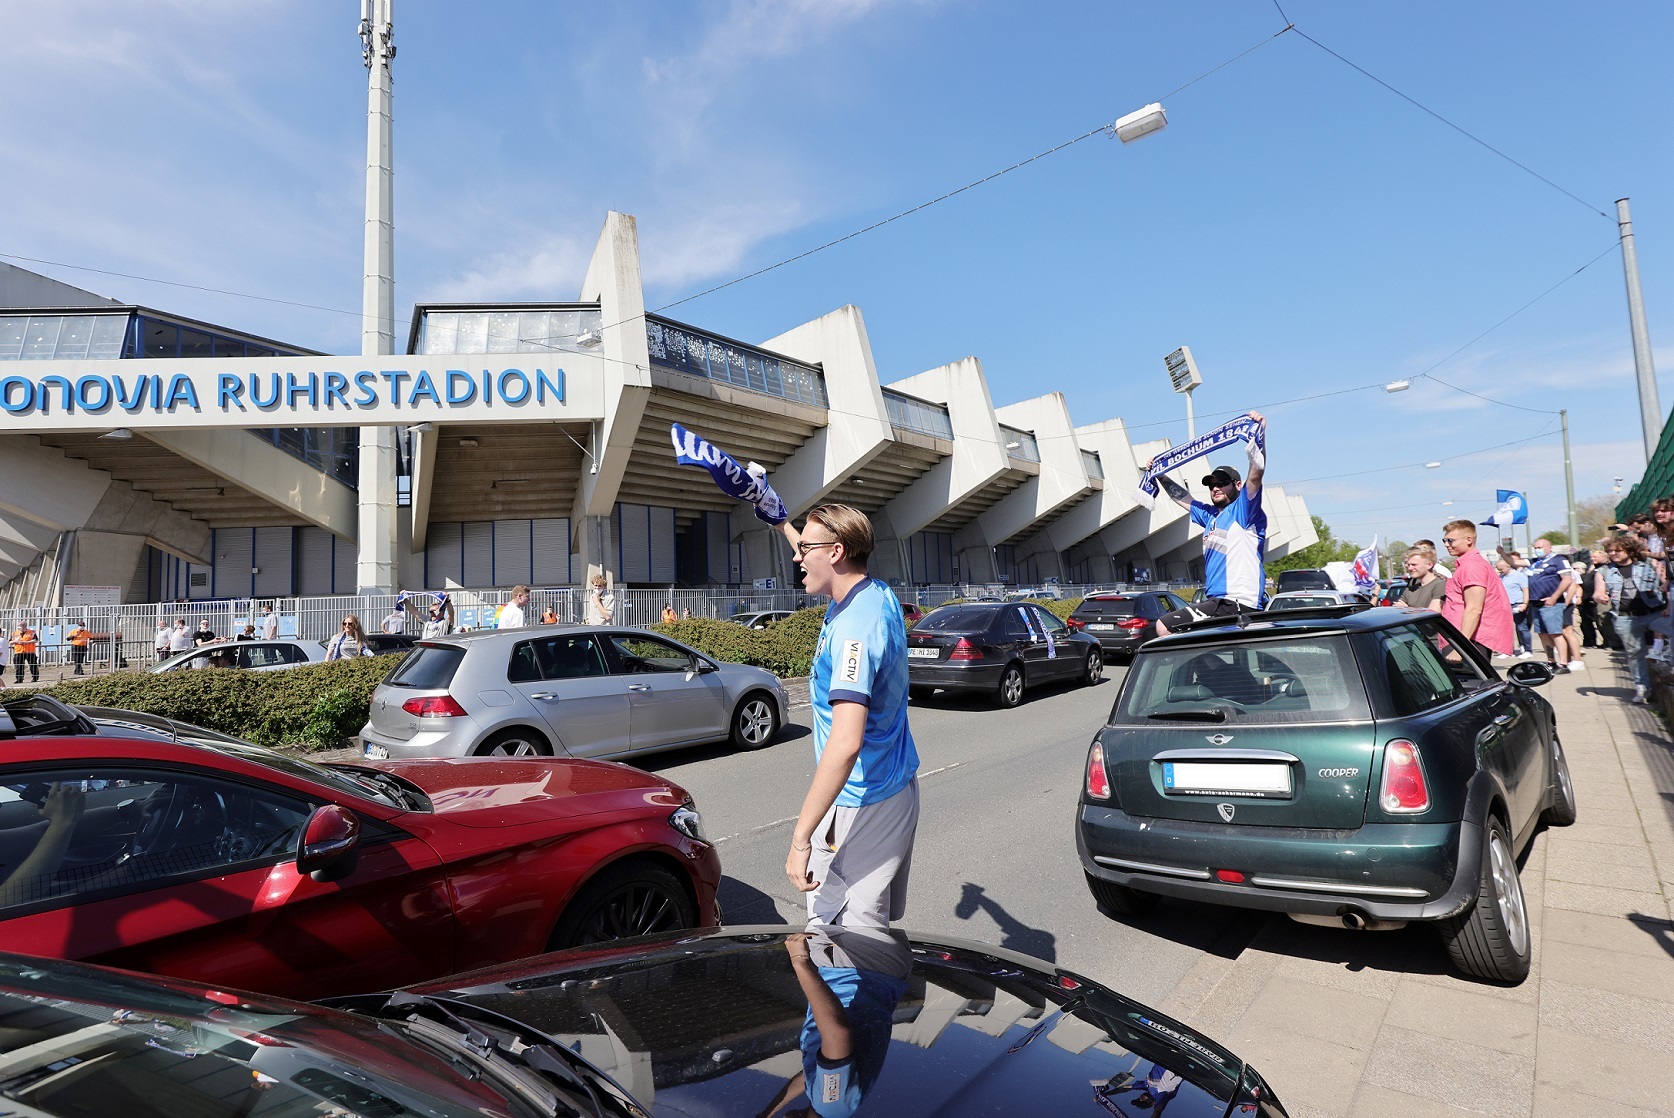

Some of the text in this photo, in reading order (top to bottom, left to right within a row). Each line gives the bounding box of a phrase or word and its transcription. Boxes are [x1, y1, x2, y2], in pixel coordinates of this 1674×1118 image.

[217, 368, 565, 407] RUHRSTADION
[1167, 438, 1214, 465] BOCHUM
[846, 642, 859, 681] VIACTIV
[1318, 767, 1359, 778] COOPER
